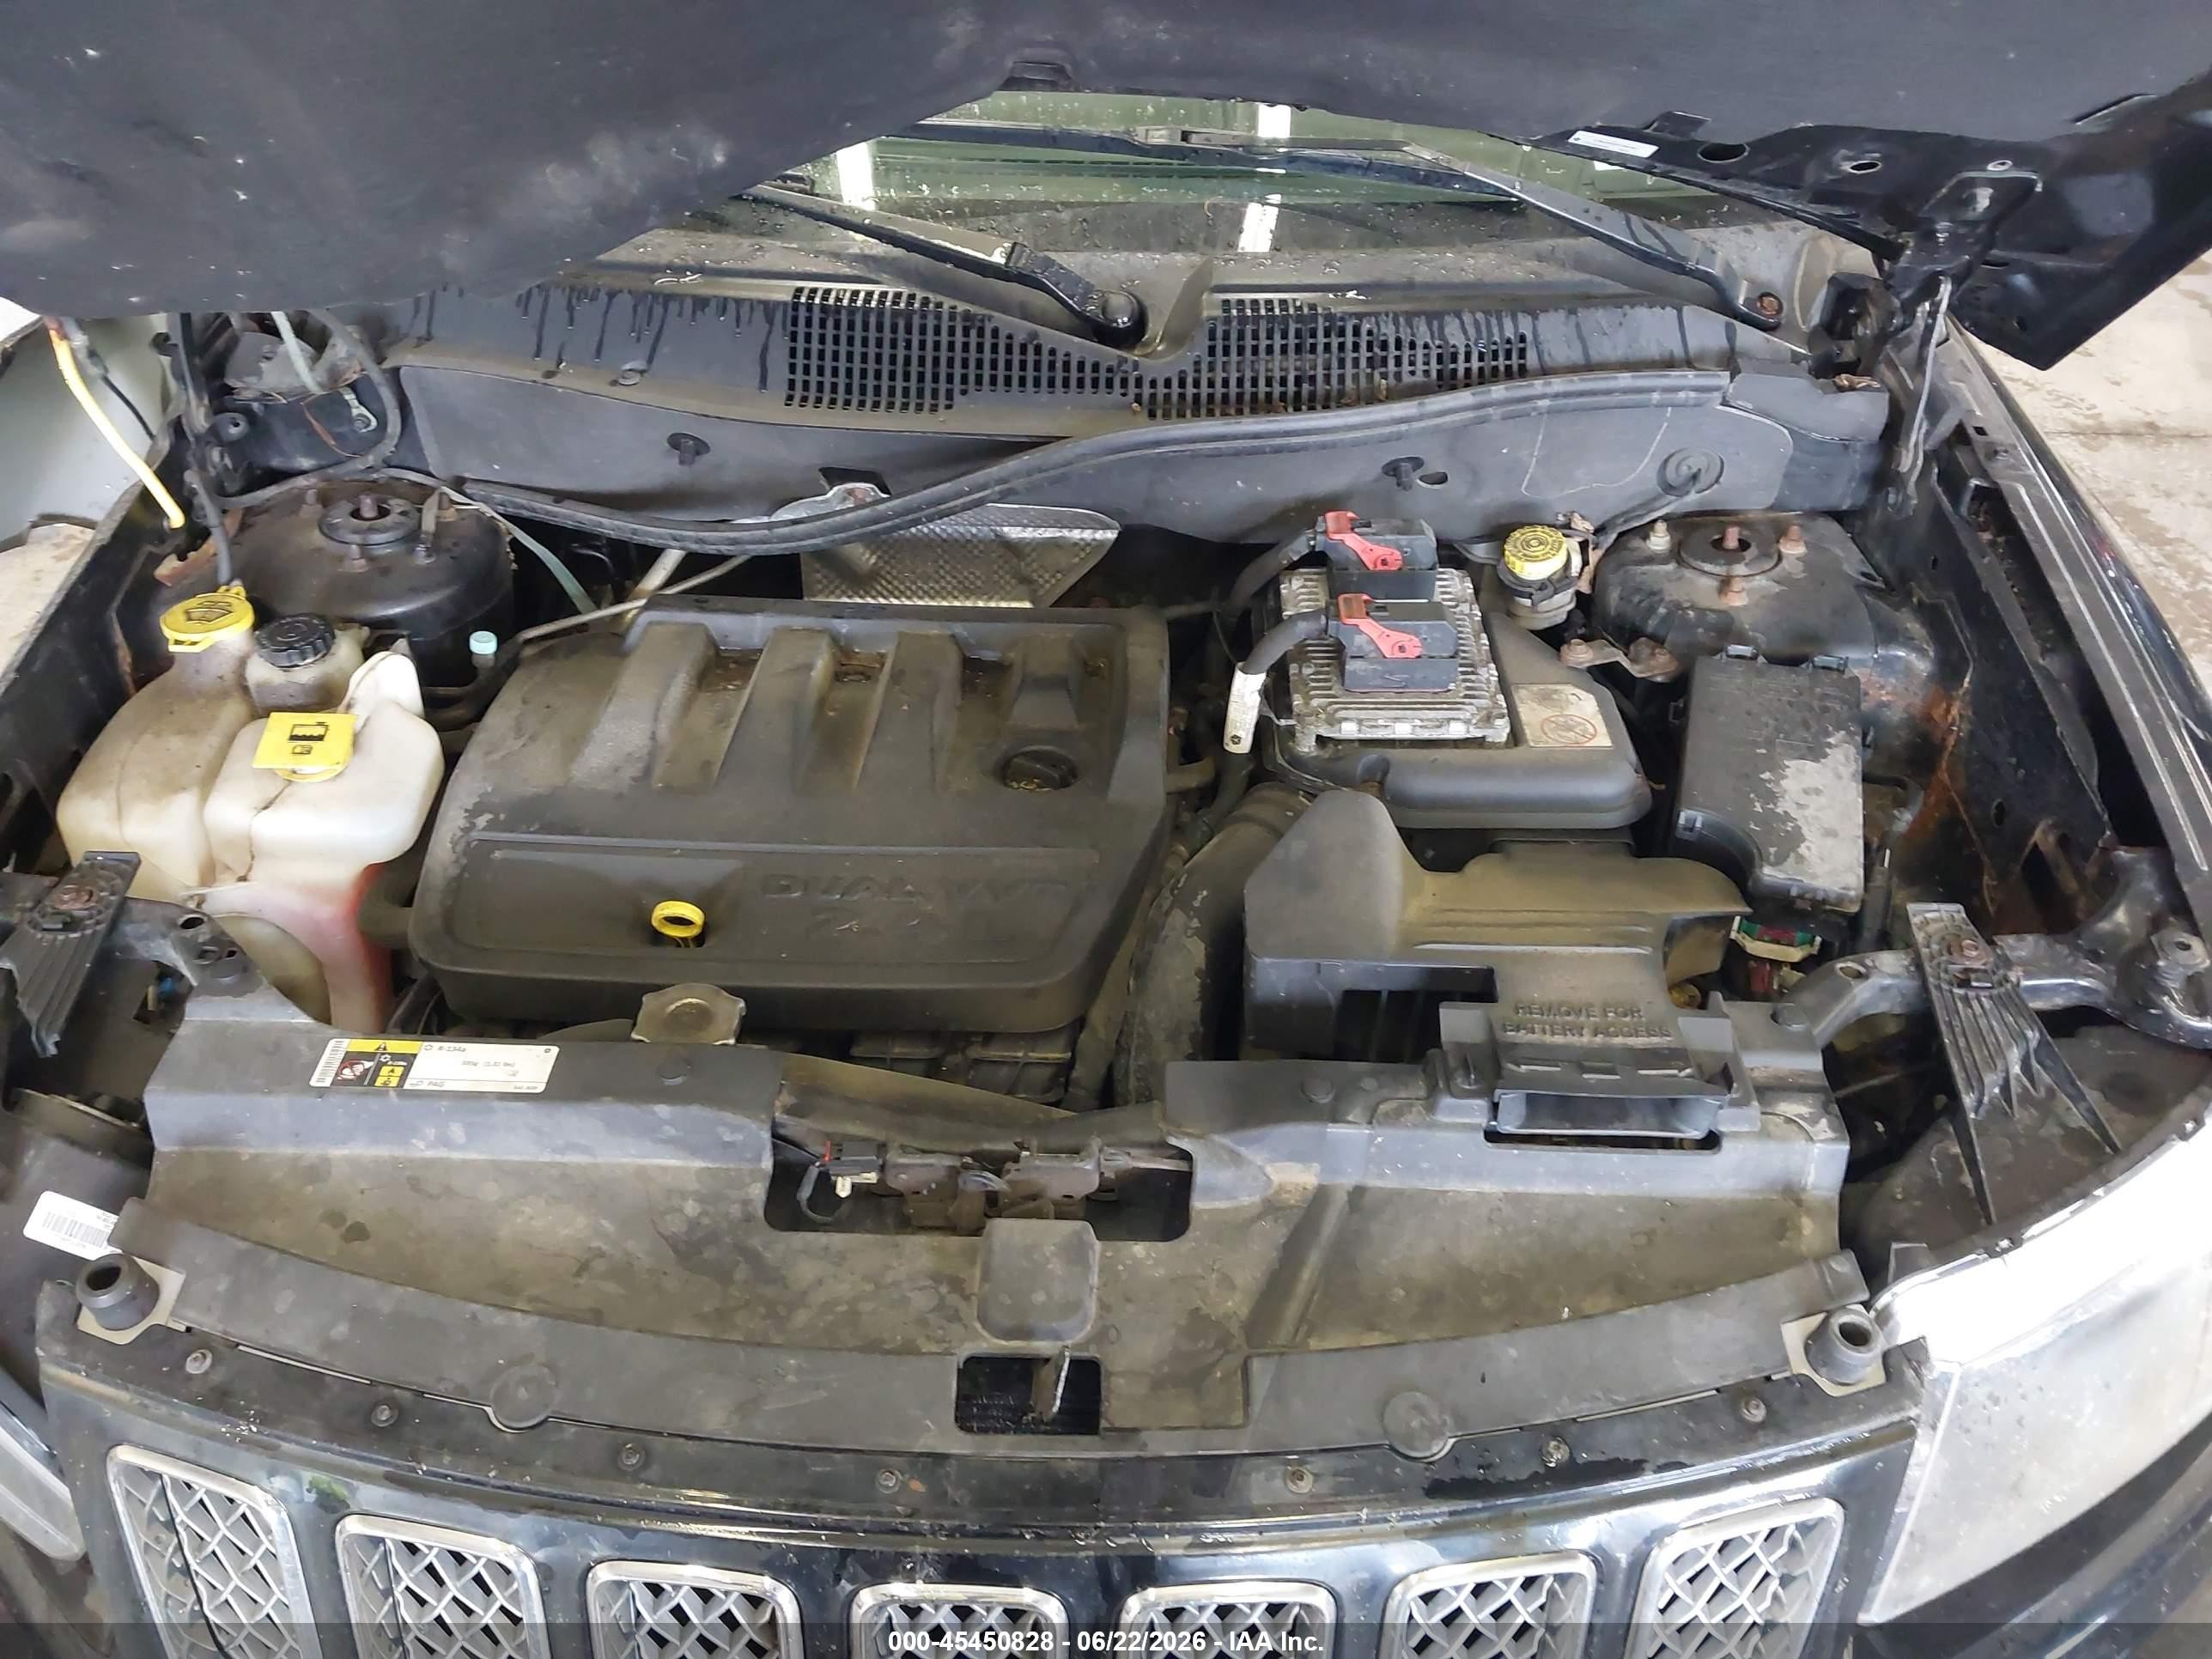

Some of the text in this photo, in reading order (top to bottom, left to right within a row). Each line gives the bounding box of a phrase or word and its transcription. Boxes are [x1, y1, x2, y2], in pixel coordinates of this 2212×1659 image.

[1515, 1002, 1644, 1022] REMOVE FOR
[1503, 1020, 1674, 1041] BATTERY ACCESS
